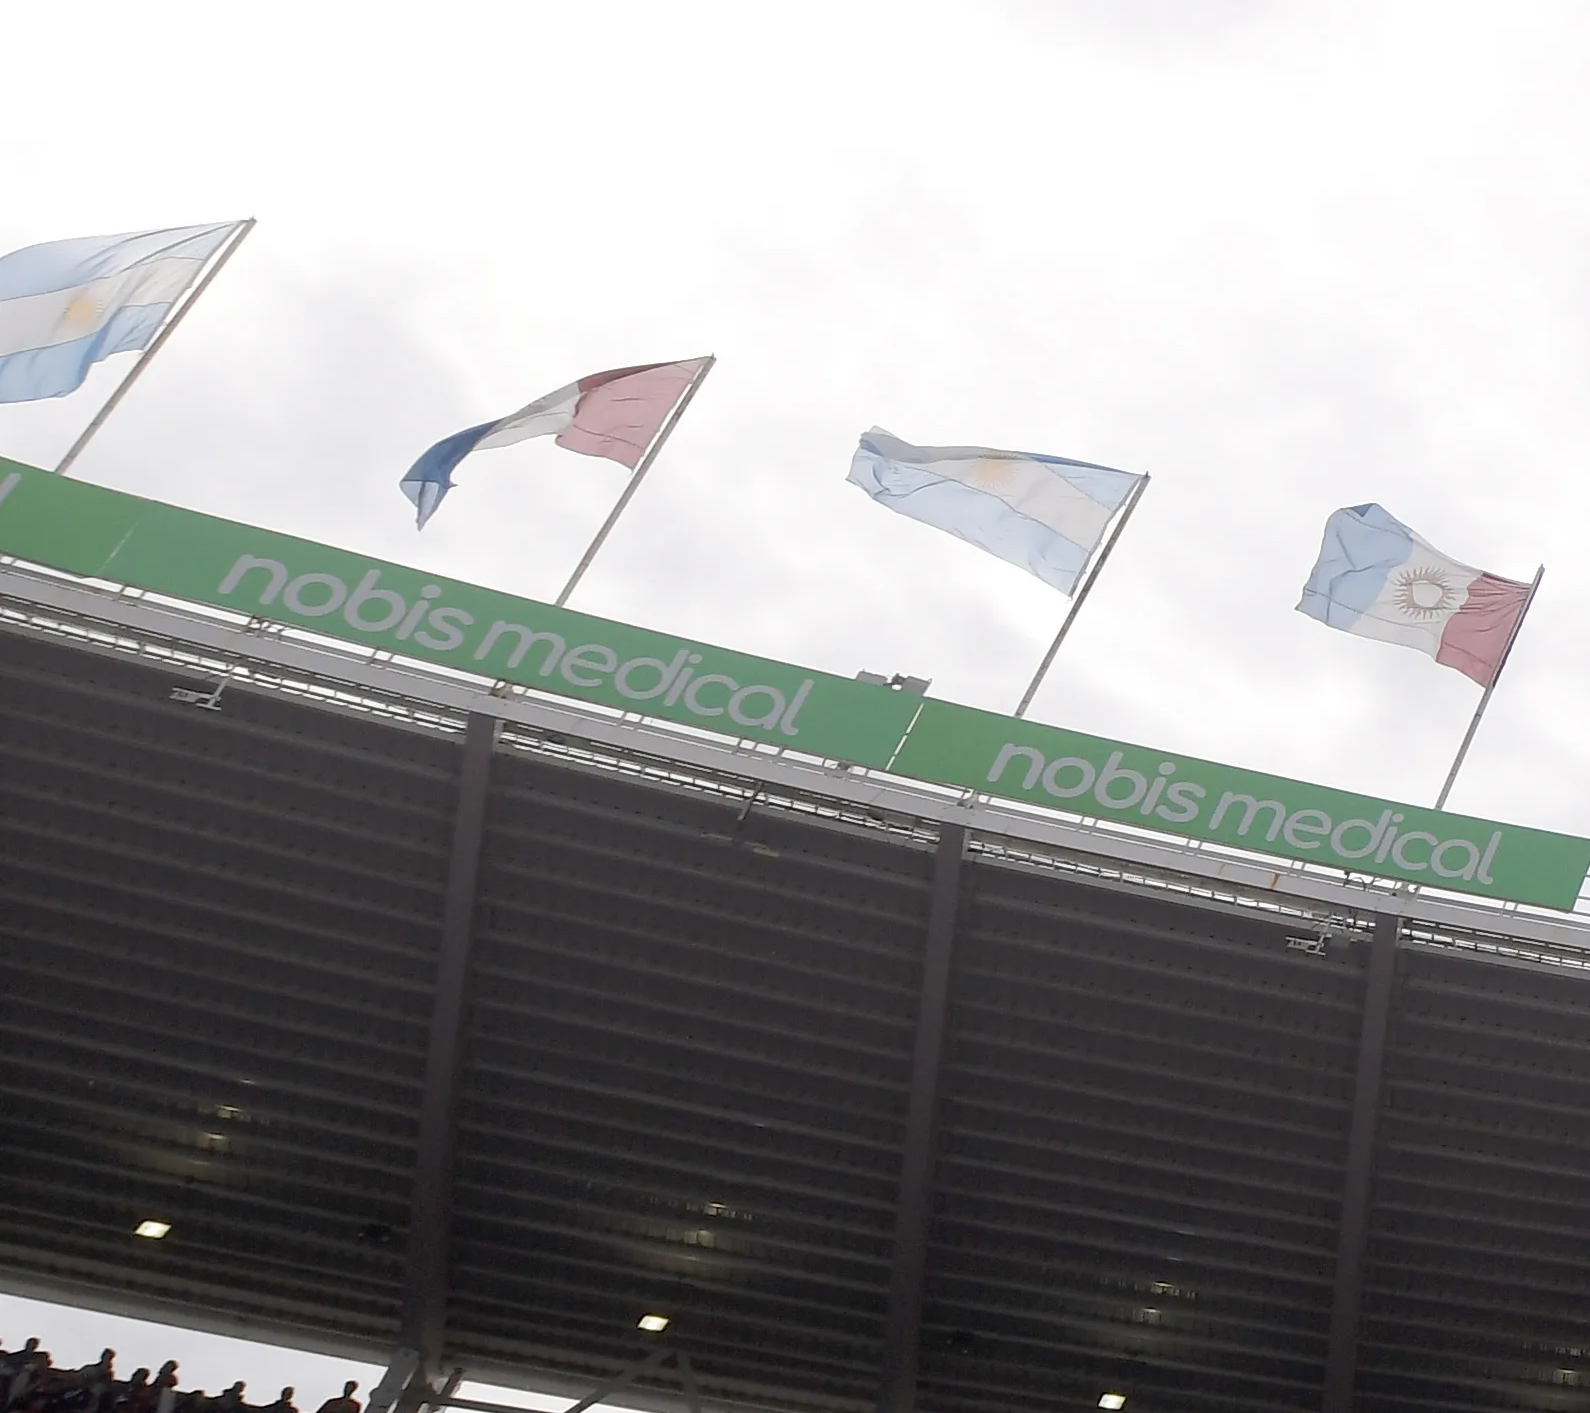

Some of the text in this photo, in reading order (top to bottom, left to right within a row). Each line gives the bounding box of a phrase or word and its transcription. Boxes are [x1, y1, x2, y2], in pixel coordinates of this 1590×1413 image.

[217, 553, 815, 736] nobis medical
[986, 742, 1502, 886] nobis medical
